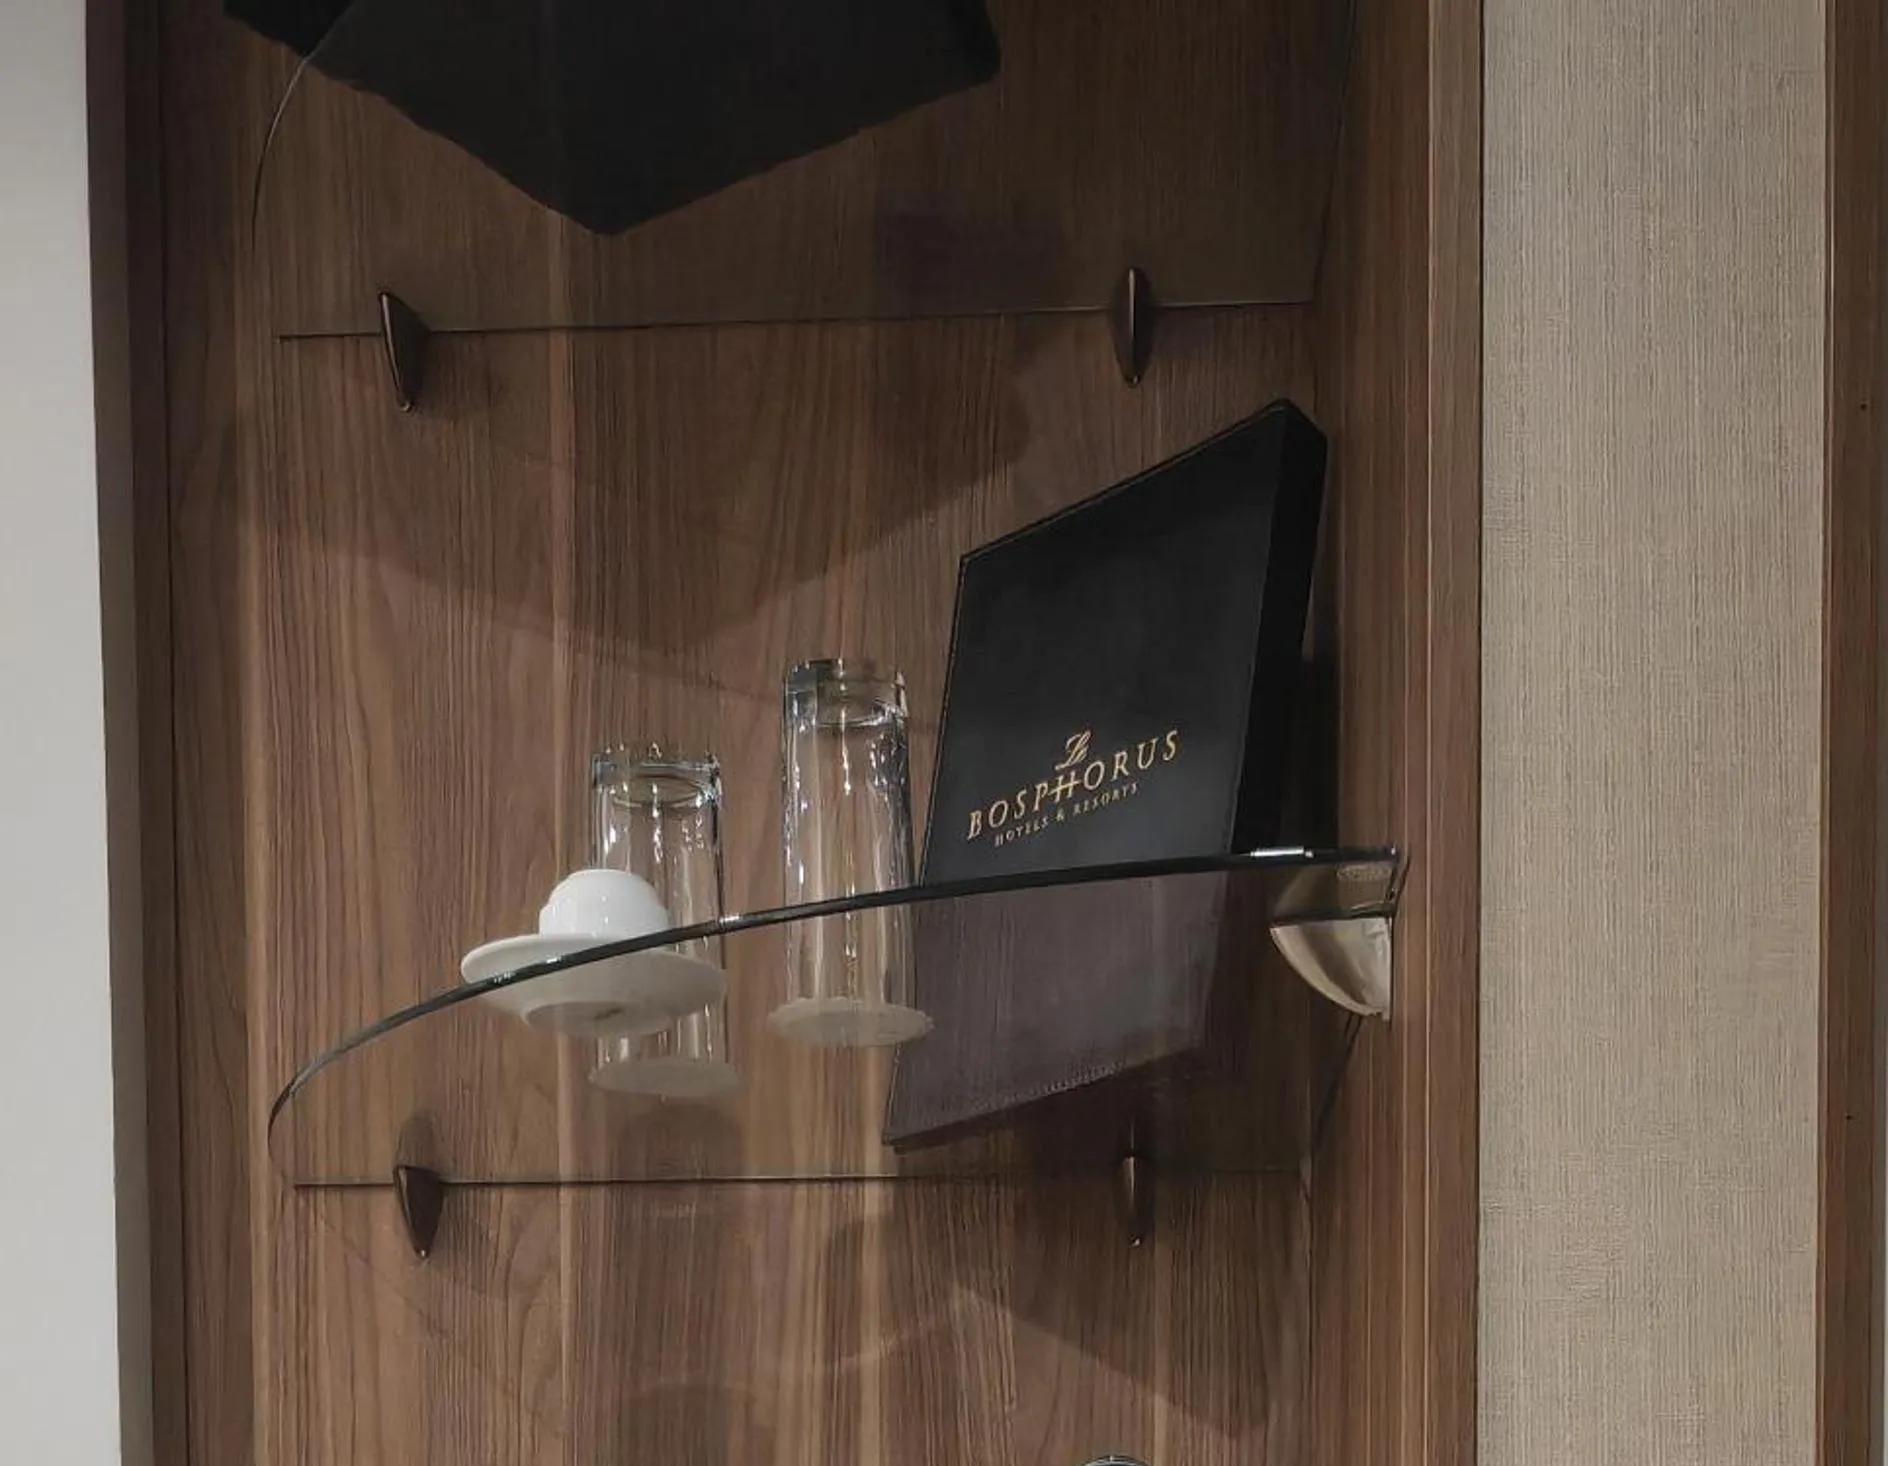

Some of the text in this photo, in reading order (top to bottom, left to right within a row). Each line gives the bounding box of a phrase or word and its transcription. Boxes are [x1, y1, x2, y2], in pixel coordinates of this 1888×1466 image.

[967, 730, 1179, 840] BOSPHORUS
[994, 782, 1138, 847] HOTELS & RESORTS
